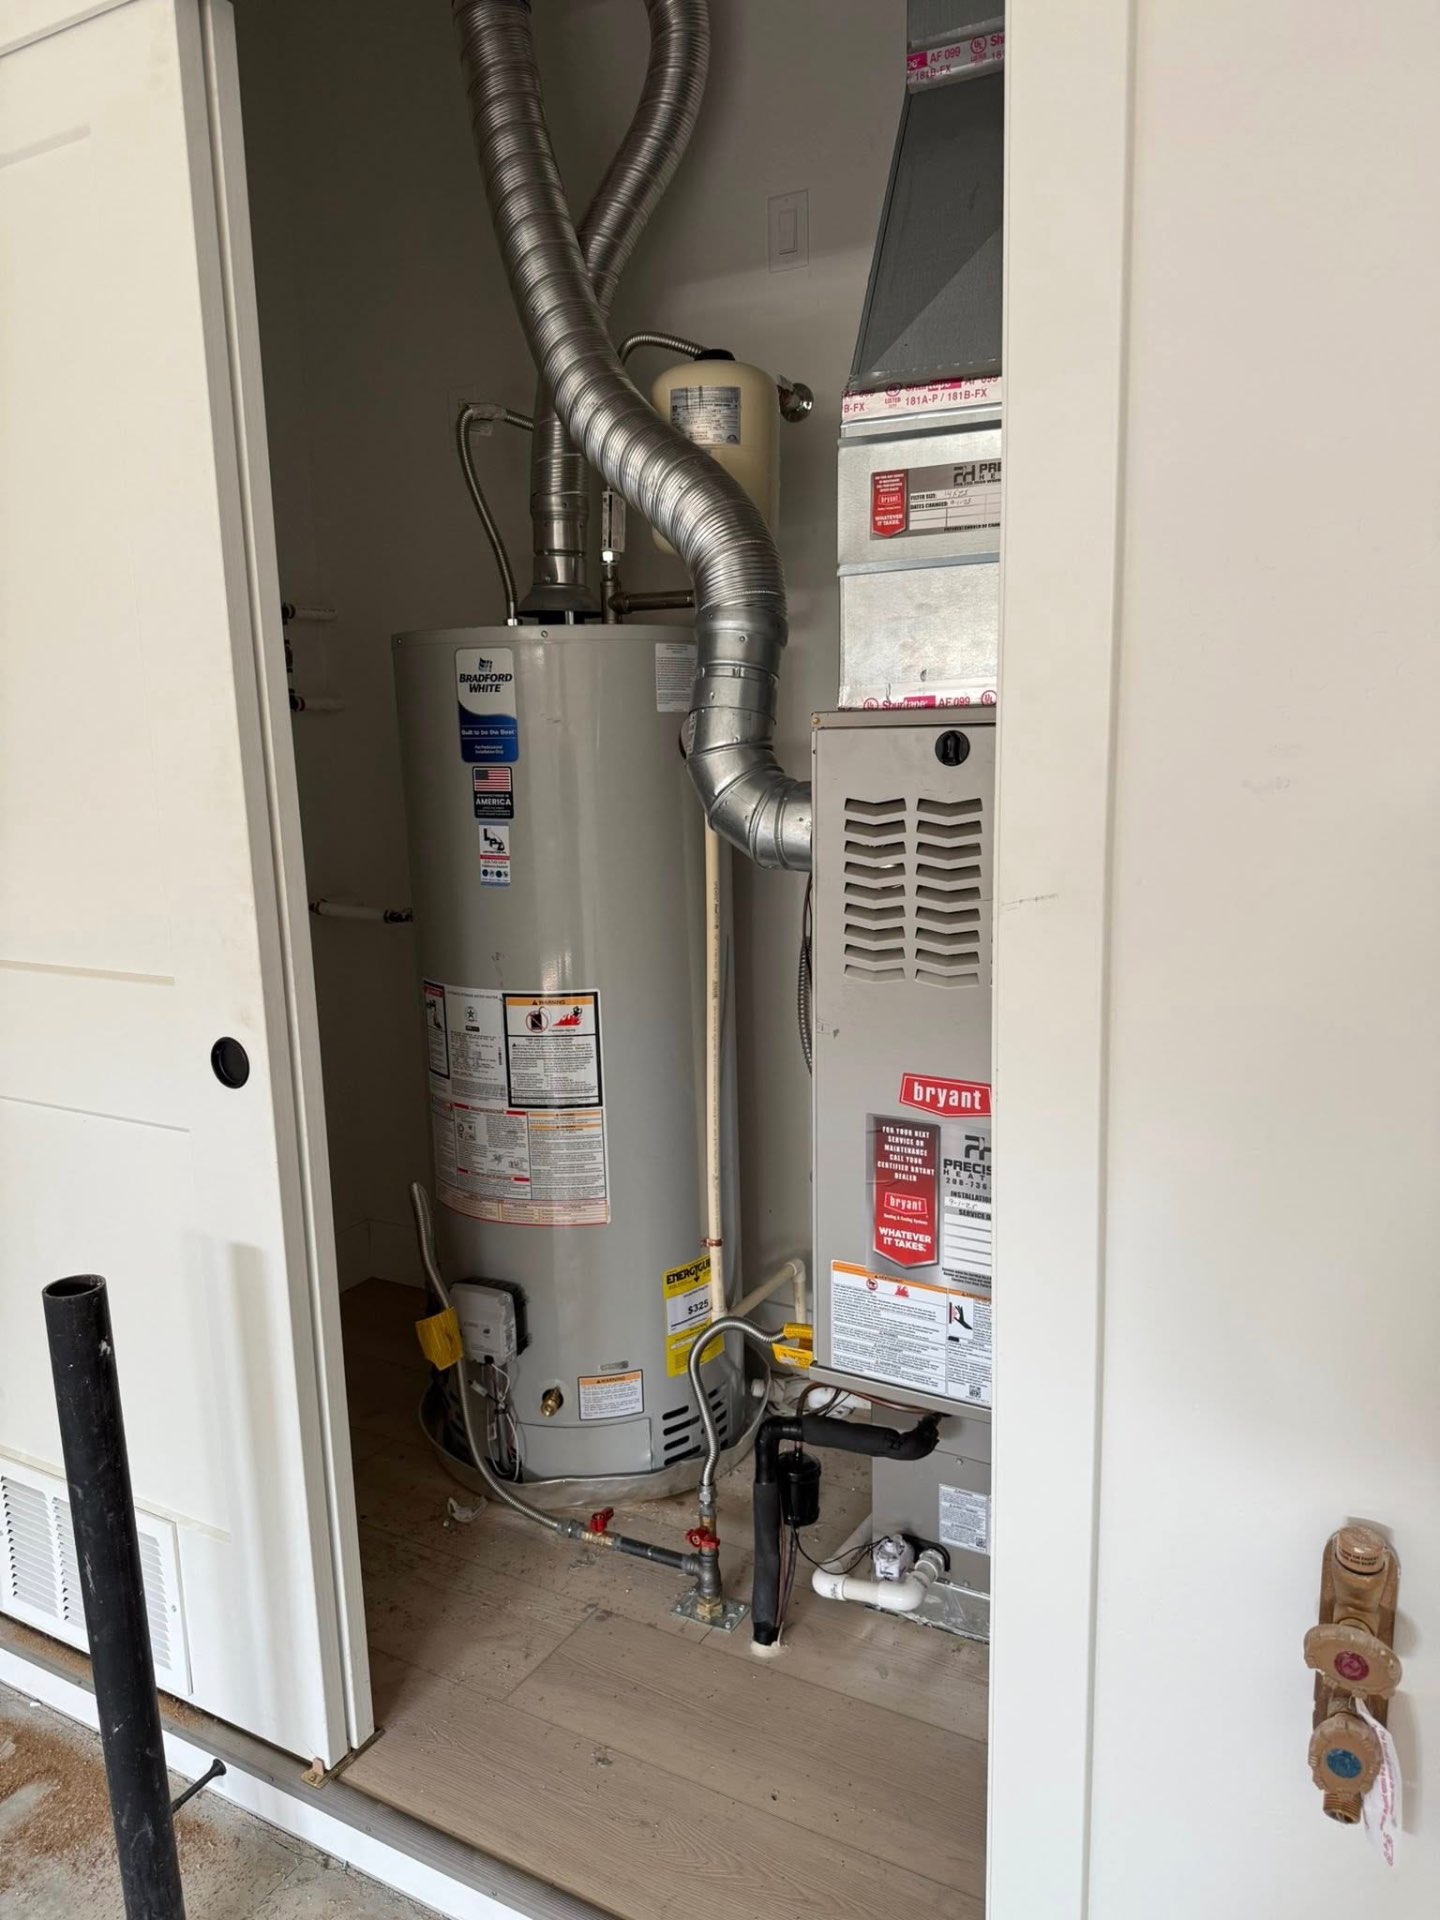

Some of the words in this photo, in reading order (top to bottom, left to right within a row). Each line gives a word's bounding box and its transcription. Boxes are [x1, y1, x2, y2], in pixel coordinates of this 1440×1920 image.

[905, 393, 938, 407] 181A-P
[947, 388, 988, 401] 181B-FX
[459, 673, 513, 683] BRADFORD
[469, 683, 502, 693] WHITE
[476, 798, 512, 806] AMERICA
[913, 1082, 982, 1110] bryant
[882, 1126, 893, 1135] FOR
[895, 1127, 913, 1137] YOUR
[914, 1129, 930, 1139] NEXT
[887, 1135, 914, 1147] SERVICE
[915, 1138, 925, 1147] OR
[884, 1144, 928, 1157] MAINTENANCE
[889, 1154, 904, 1163] CALL
[905, 1155, 923, 1165] YOUR
[877, 1160, 909, 1172] CERTIFIED
[910, 1165, 935, 1176] BRYANT
[894, 1172, 917, 1182] DEALER
[889, 1195, 922, 1211] bryant
[878, 1226, 932, 1244] WHATEVER
[883, 1237, 893, 1246] IT
[688, 1299, 709, 1315] $325
[601, 1376, 626, 1384] WARNING
